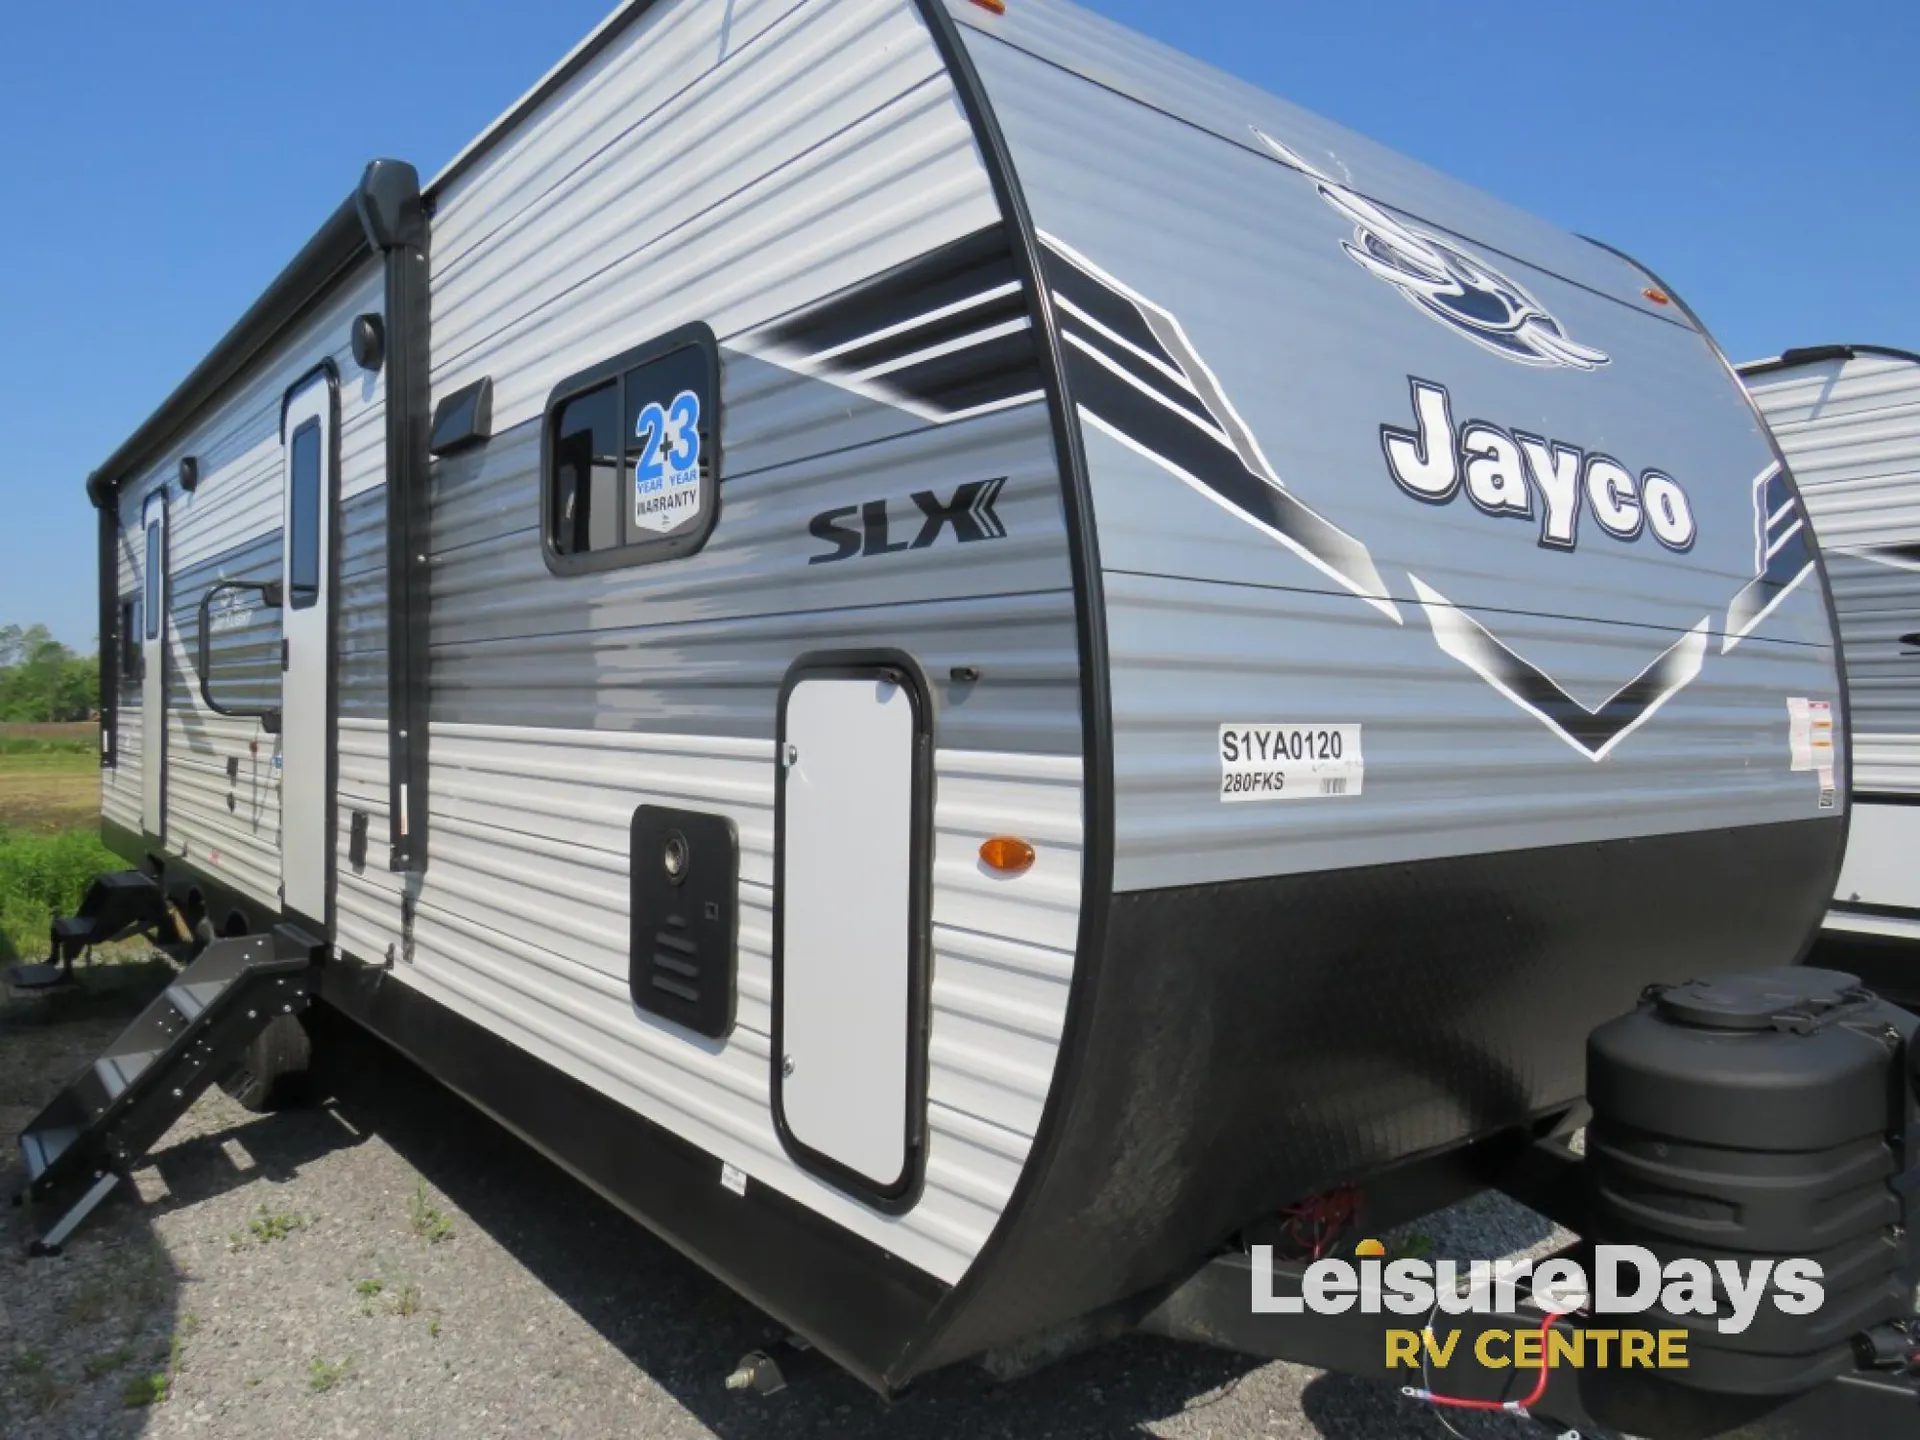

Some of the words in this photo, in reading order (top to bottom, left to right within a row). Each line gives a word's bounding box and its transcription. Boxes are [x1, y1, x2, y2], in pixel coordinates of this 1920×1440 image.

[1379, 374, 1697, 554] Jayco
[637, 475, 663, 495] YEAR
[669, 468, 698, 487] YEAR
[637, 489, 697, 516] WARRANTY
[808, 476, 1009, 565] SLX
[1222, 730, 1343, 762] S1YA0120
[1223, 771, 1286, 794] 280FKS
